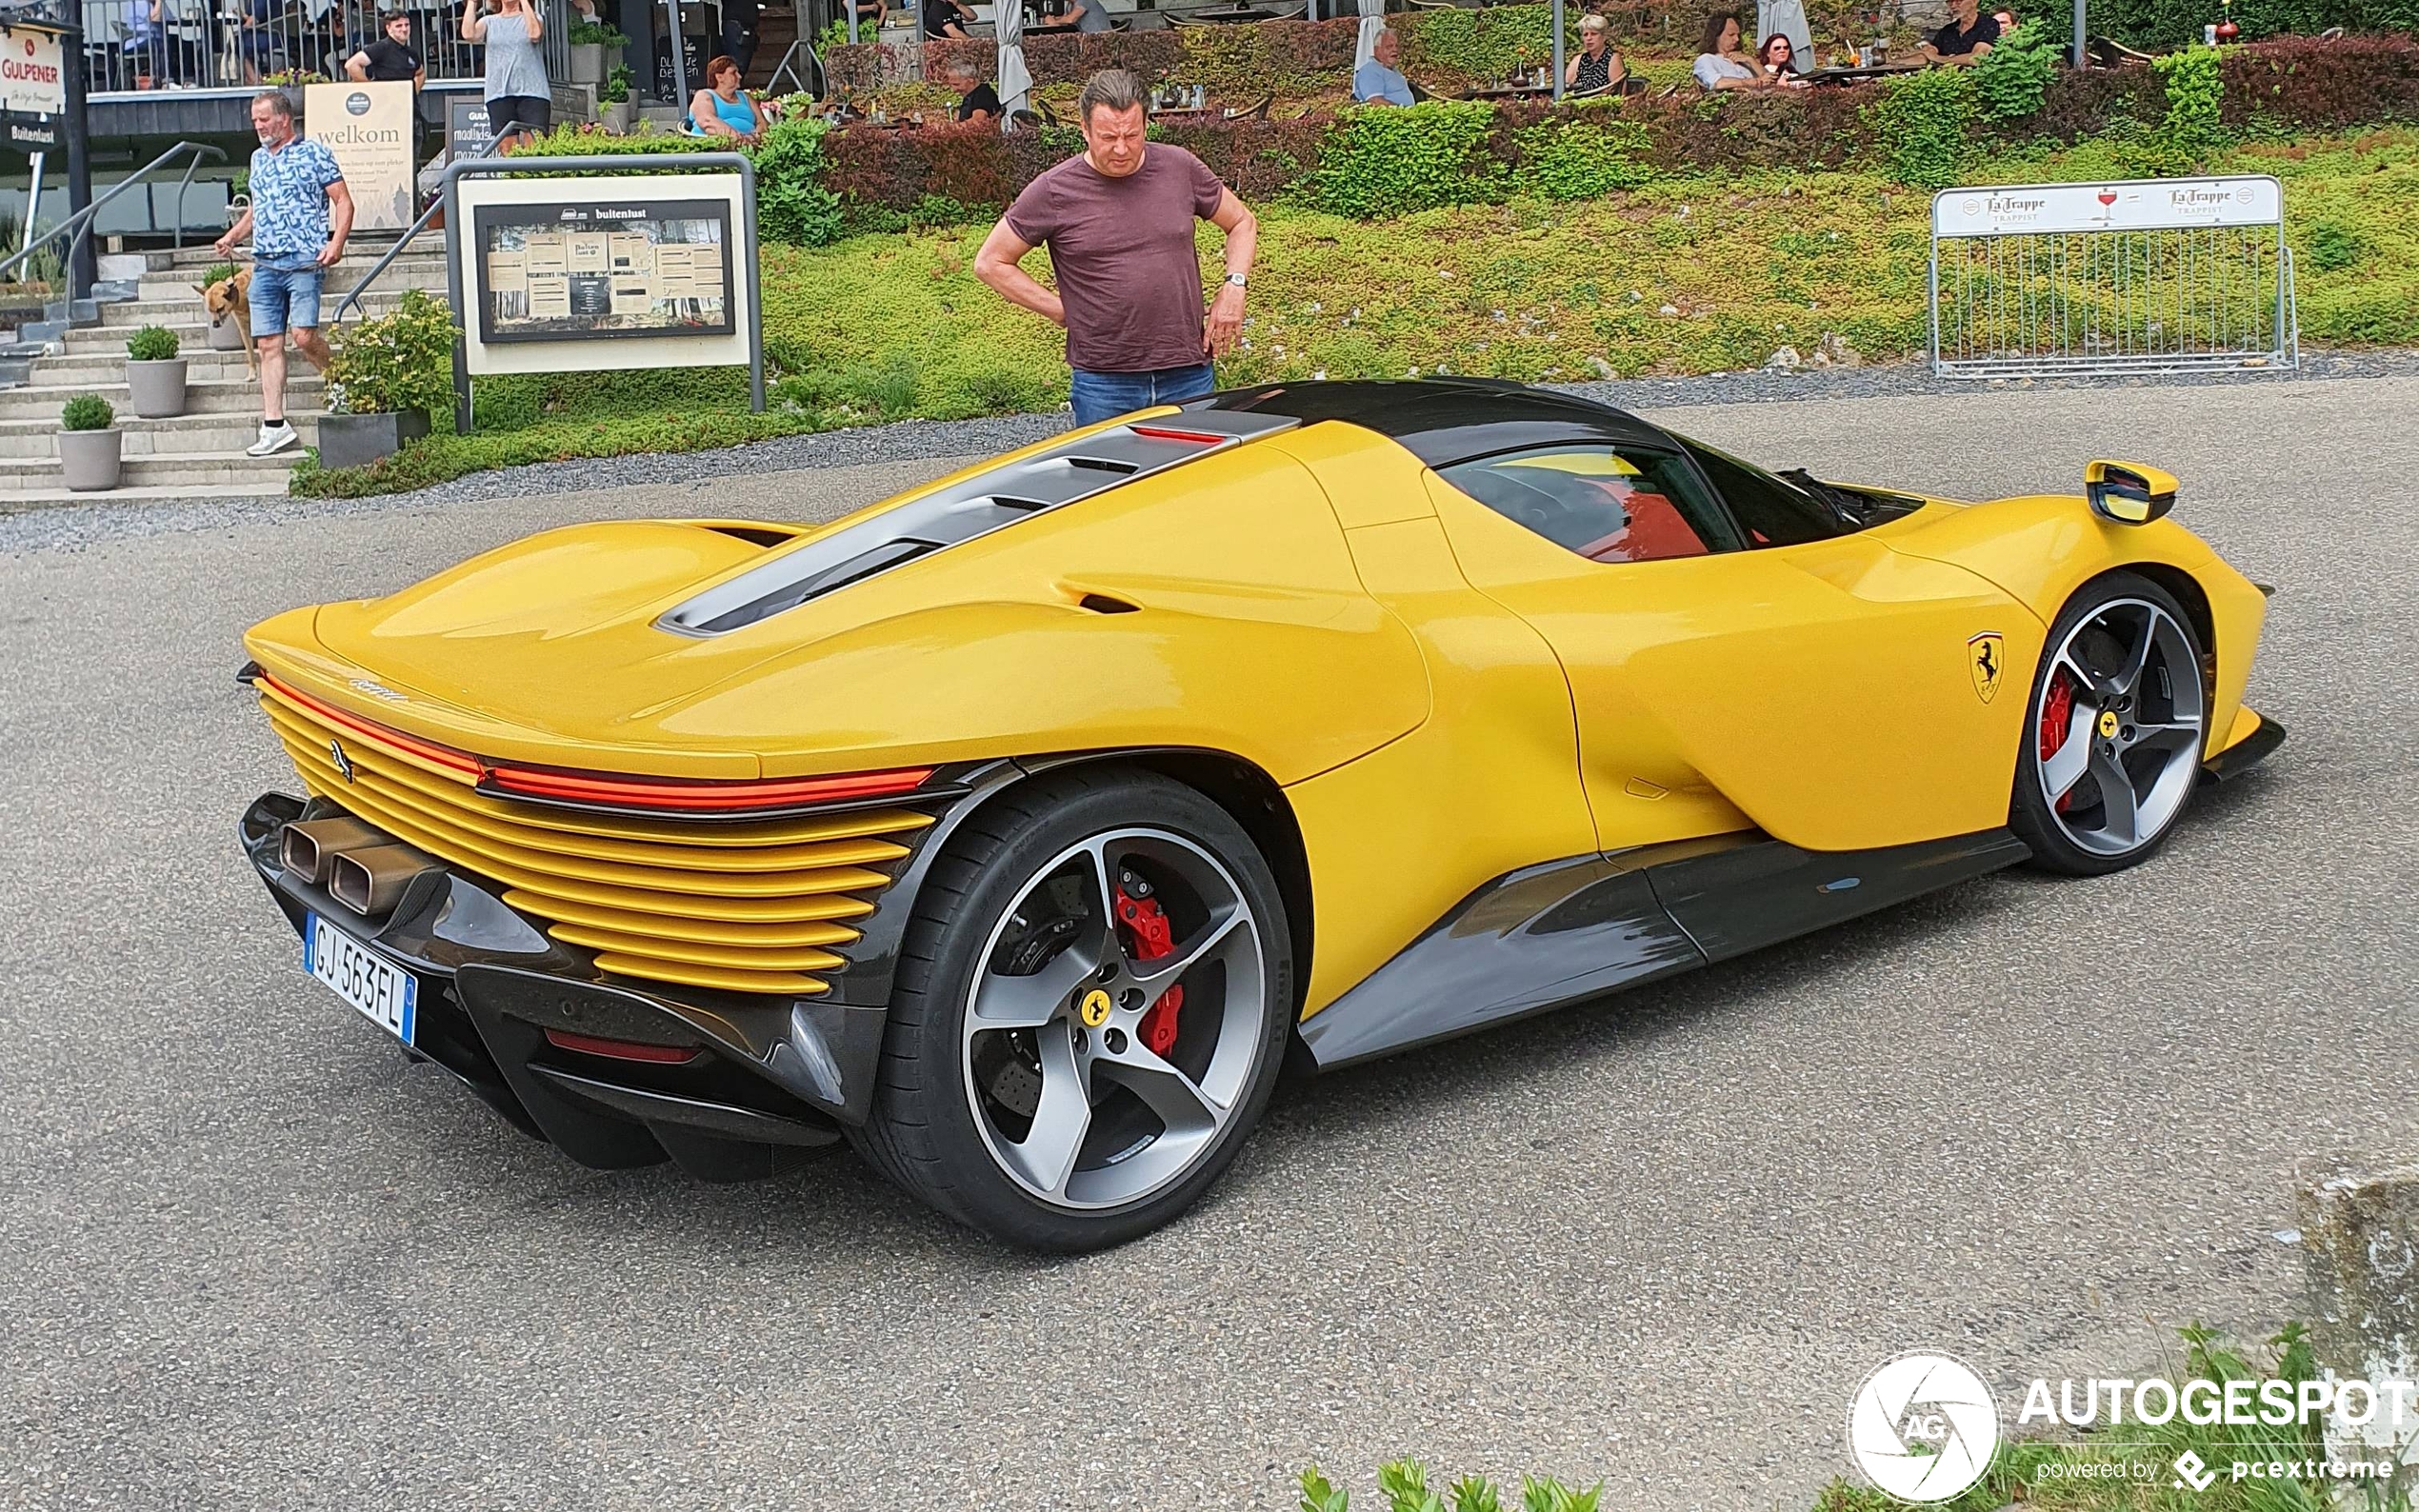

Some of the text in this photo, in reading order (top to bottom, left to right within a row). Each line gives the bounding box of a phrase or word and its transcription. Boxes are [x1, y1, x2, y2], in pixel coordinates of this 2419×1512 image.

[2, 58, 58, 84] GULPENER
[11, 125, 54, 144] Buitenlust
[317, 125, 399, 144] welkom
[595, 209, 647, 220] buitenlust
[1993, 213, 2038, 223] TRAPPIST
[2177, 206, 2223, 215] TRAPPIST
